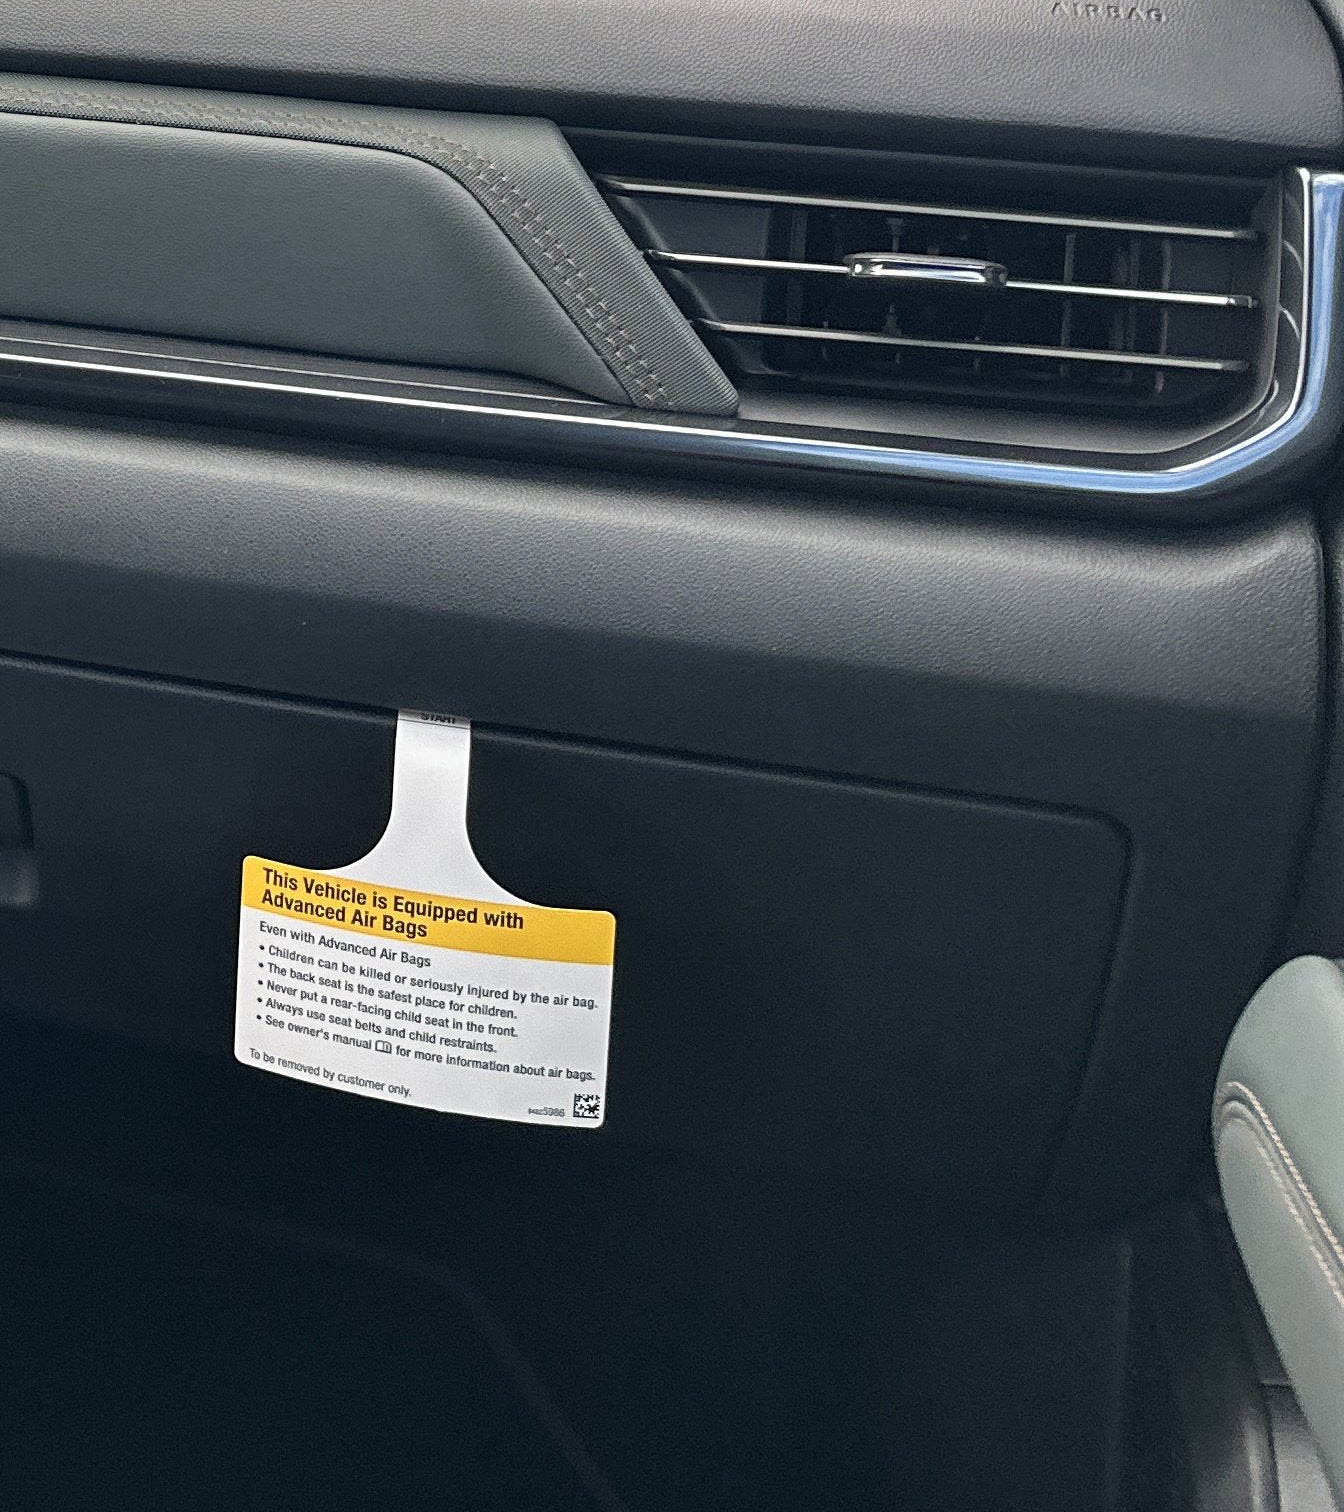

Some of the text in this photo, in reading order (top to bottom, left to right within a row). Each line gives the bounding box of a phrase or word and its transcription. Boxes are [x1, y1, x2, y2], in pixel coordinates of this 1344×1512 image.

[1051, 1, 1166, 23] AIRBAG
[261, 889, 428, 939] Advanced Air Bags
[263, 867, 524, 929] This Vehicle is Equipped with
[259, 920, 432, 968] Even with Advanced Air Bags
[267, 962, 518, 1019] The back seat is the safest place for children.
[268, 944, 599, 1010] Children can be killed or seriously injured by the air bag.
[265, 997, 497, 1053] Always use seat belts and child restraints.
[267, 980, 519, 1037] Never put a rear-facing child seat in the front.
[249, 1047, 412, 1097] To be removed by customer only.
[265, 1014, 596, 1083] See owner's manual for more information about air bags.
